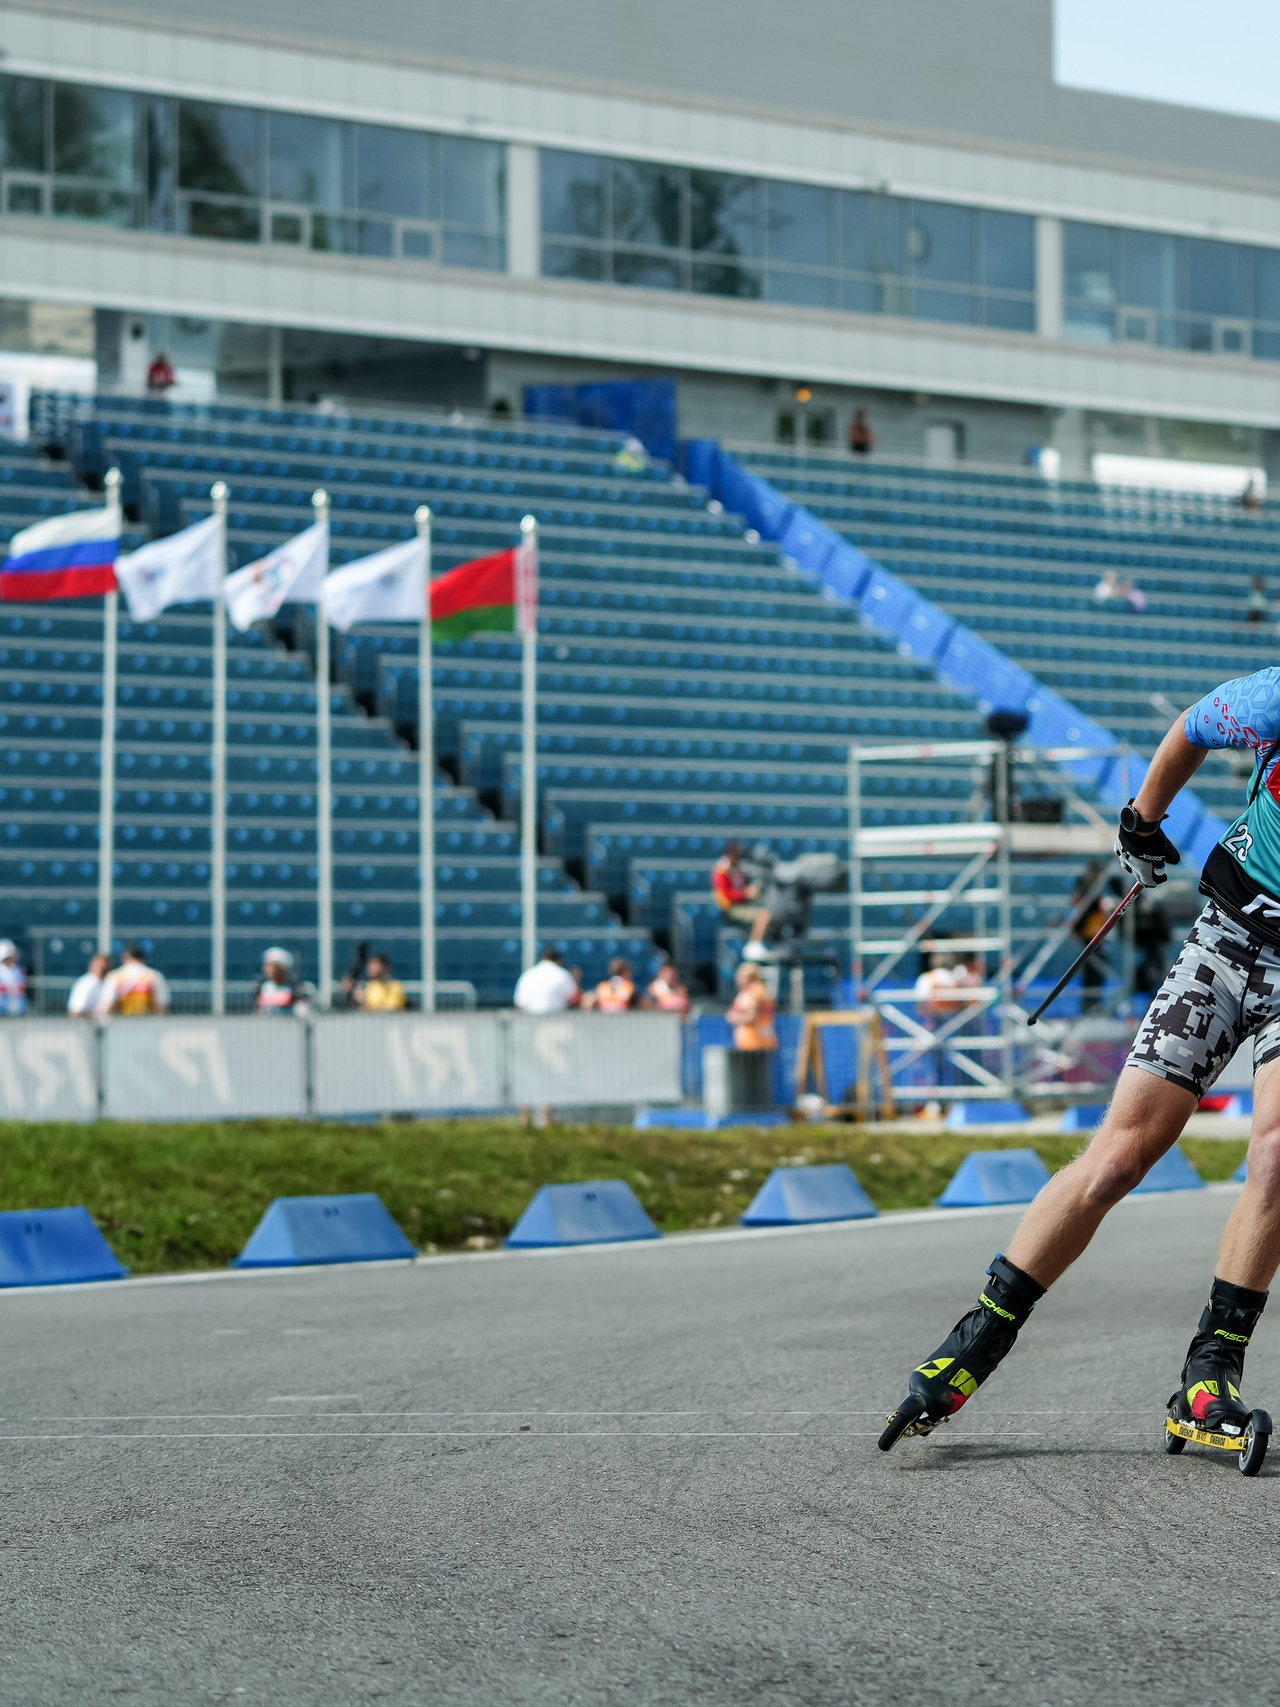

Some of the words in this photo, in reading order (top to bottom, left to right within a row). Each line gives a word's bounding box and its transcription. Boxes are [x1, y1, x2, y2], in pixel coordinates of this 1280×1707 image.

[1223, 823, 1254, 863] 23
[980, 1292, 1016, 1322] SCHER
[1178, 1426, 1195, 1439] SWENOR
[1209, 1434, 1226, 1447] SWENOR
